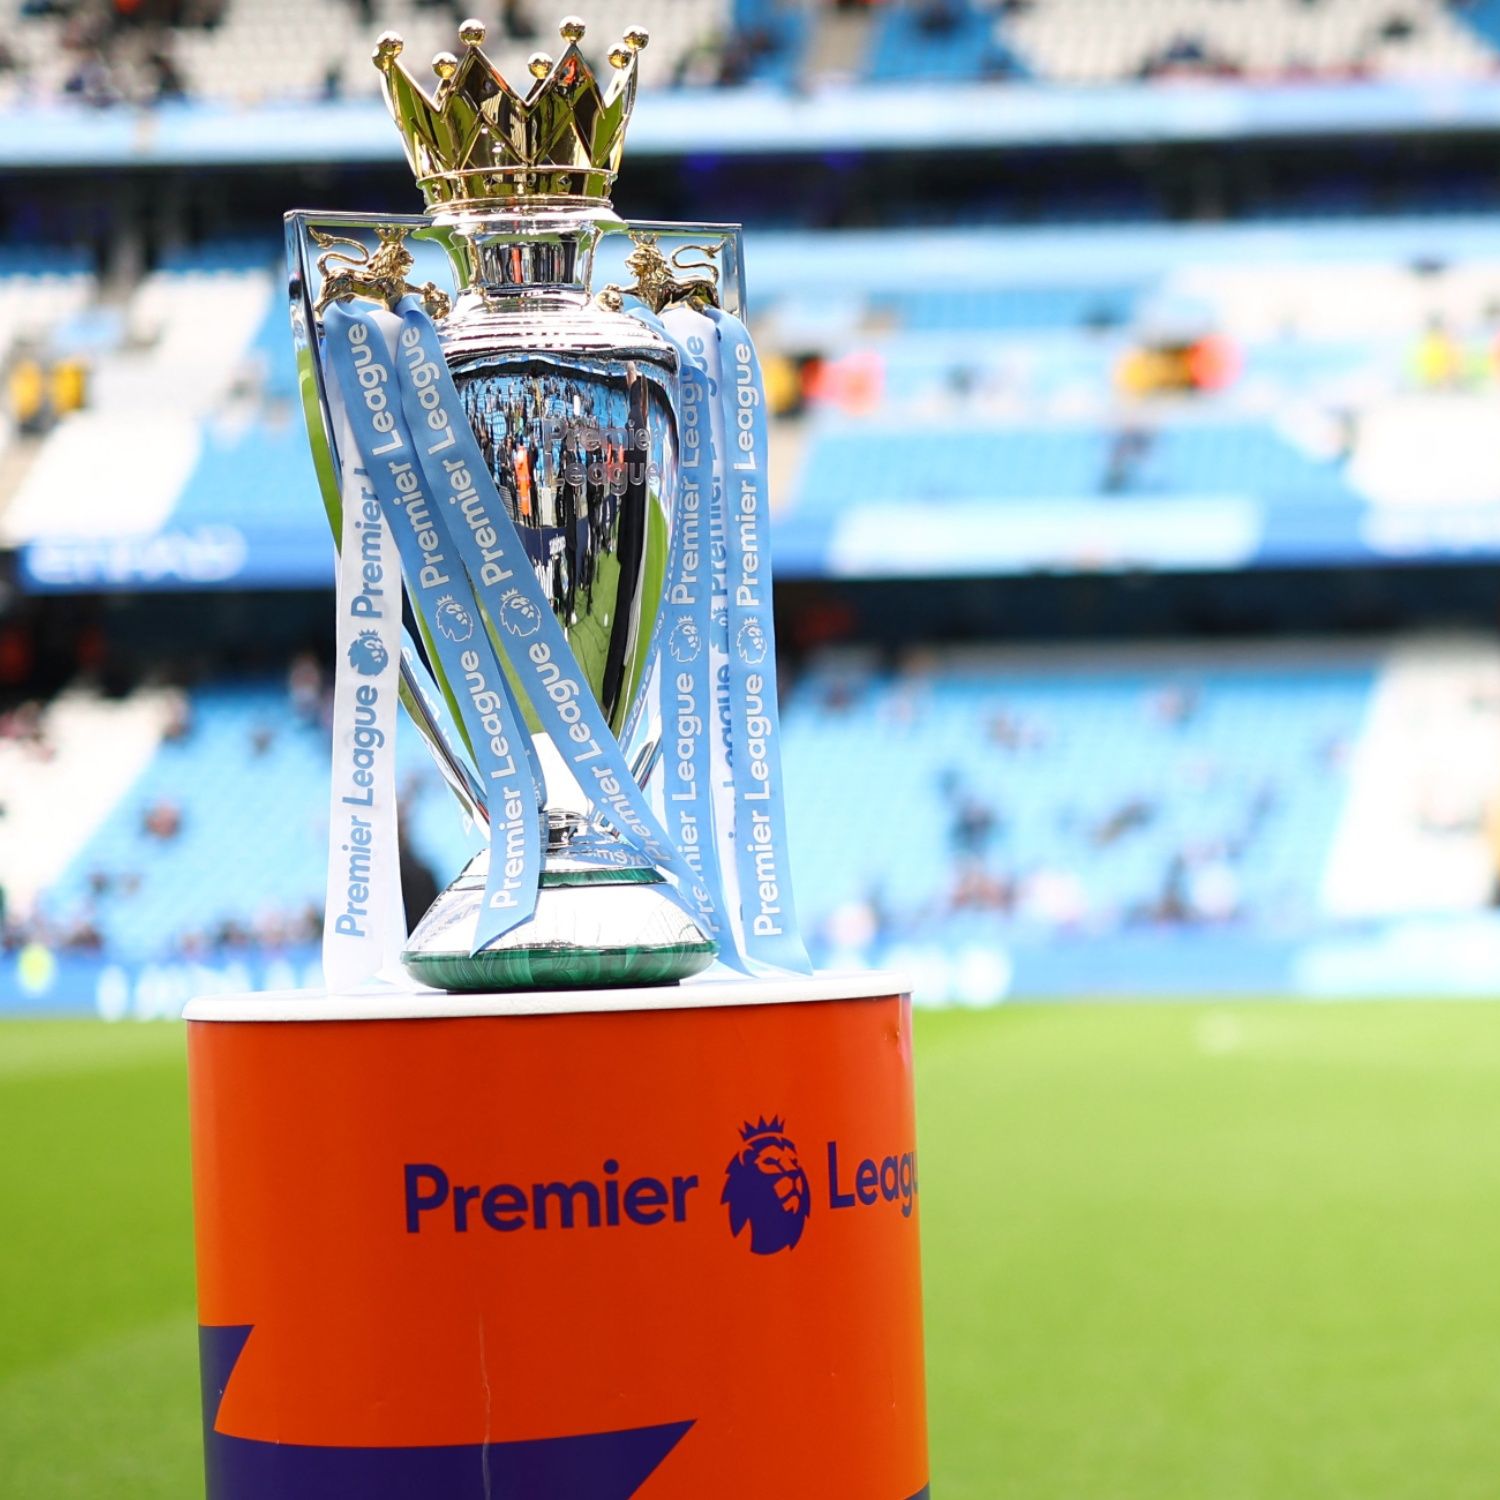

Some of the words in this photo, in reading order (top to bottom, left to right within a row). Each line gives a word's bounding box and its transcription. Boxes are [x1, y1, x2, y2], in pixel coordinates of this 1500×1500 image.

[348, 323, 403, 456] League
[402, 326, 456, 455] League
[542, 417, 660, 455] Premie
[734, 343, 760, 470] League
[350, 484, 383, 619] Premier
[393, 461, 449, 589] Premier
[441, 459, 514, 587] Premier
[671, 480, 700, 605] Premier
[736, 480, 760, 607] Premier
[342, 684, 385, 808] League
[461, 650, 516, 779] League
[529, 642, 602, 763] League
[671, 672, 702, 801] League
[744, 672, 773, 801] League
[335, 815, 373, 937] Premier
[490, 785, 525, 909] Premier
[747, 810, 782, 937] Premier
[403, 1159, 698, 1234] Premier
